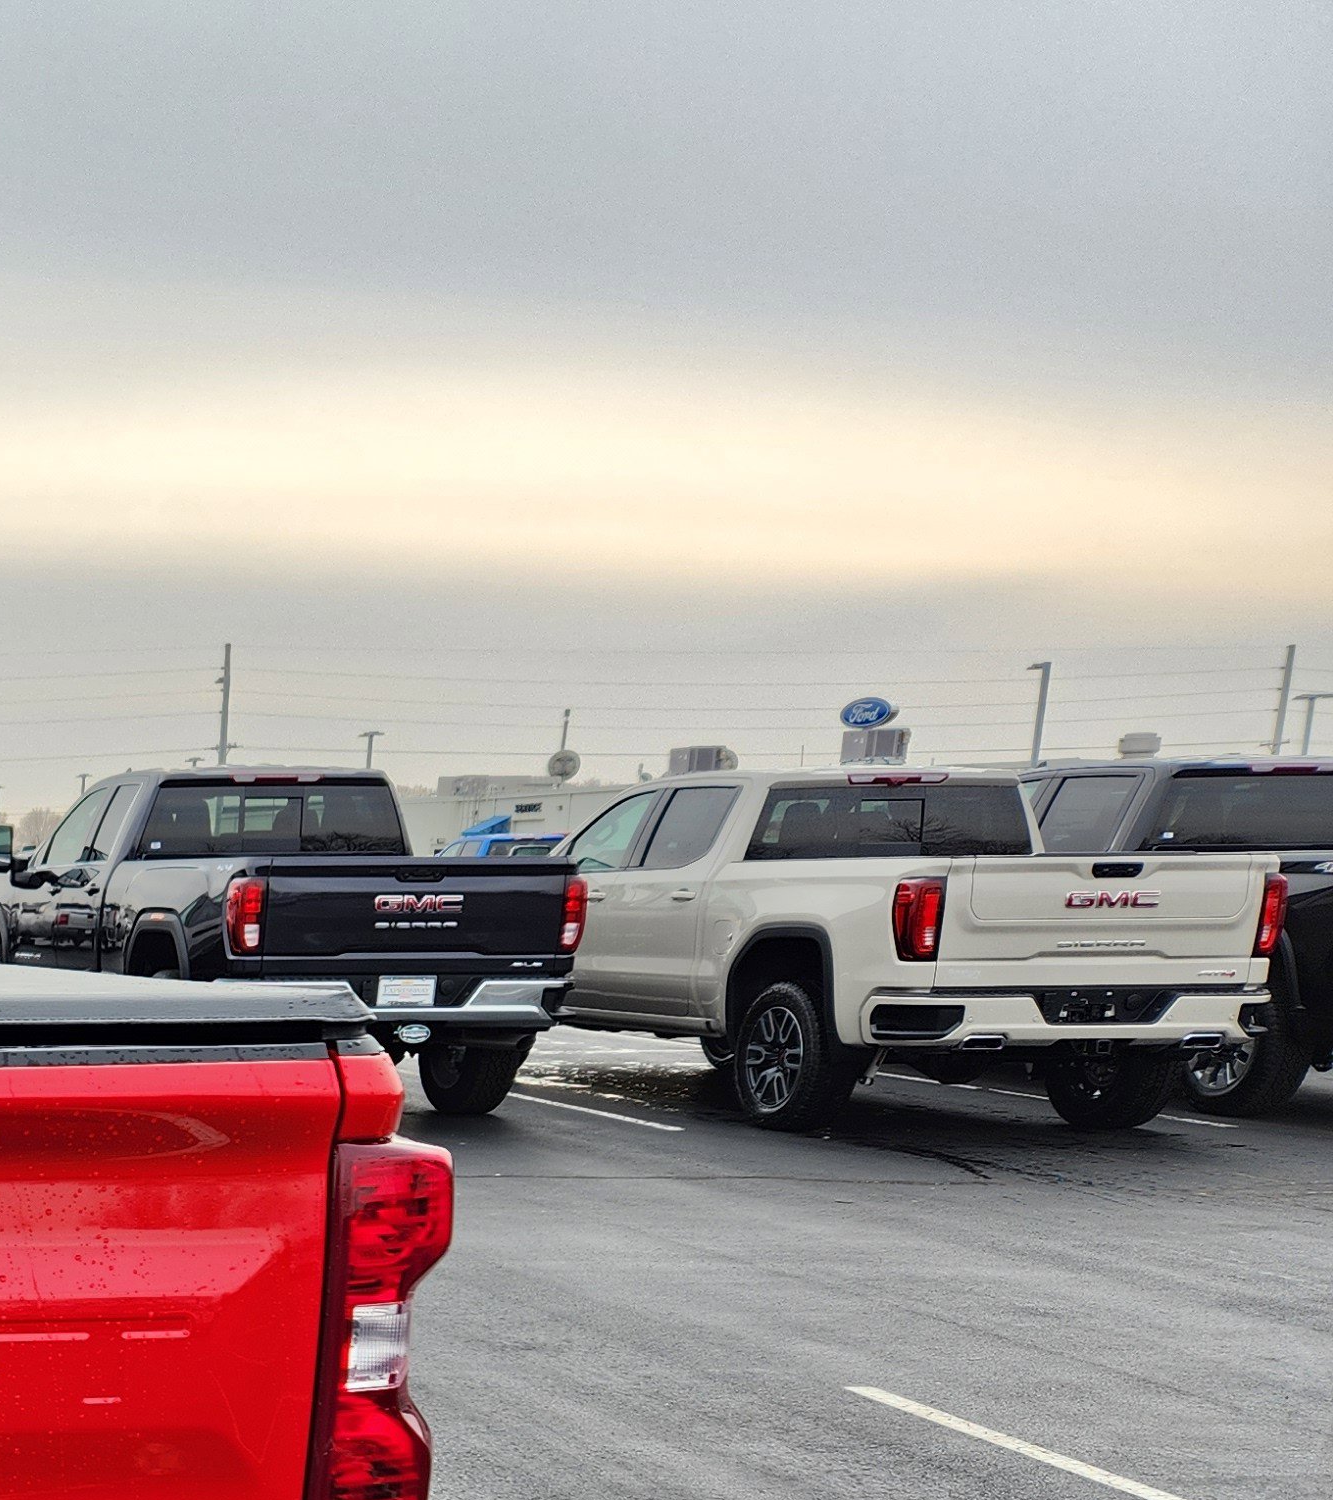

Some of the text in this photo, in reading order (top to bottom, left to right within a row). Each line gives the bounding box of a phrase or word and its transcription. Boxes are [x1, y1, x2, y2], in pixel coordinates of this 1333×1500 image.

[848, 703, 881, 723] Ford
[374, 894, 465, 914] GMC
[1065, 890, 1162, 909] GMC
[374, 921, 459, 930] SIERRA
[1056, 940, 1147, 949] SIERRA
